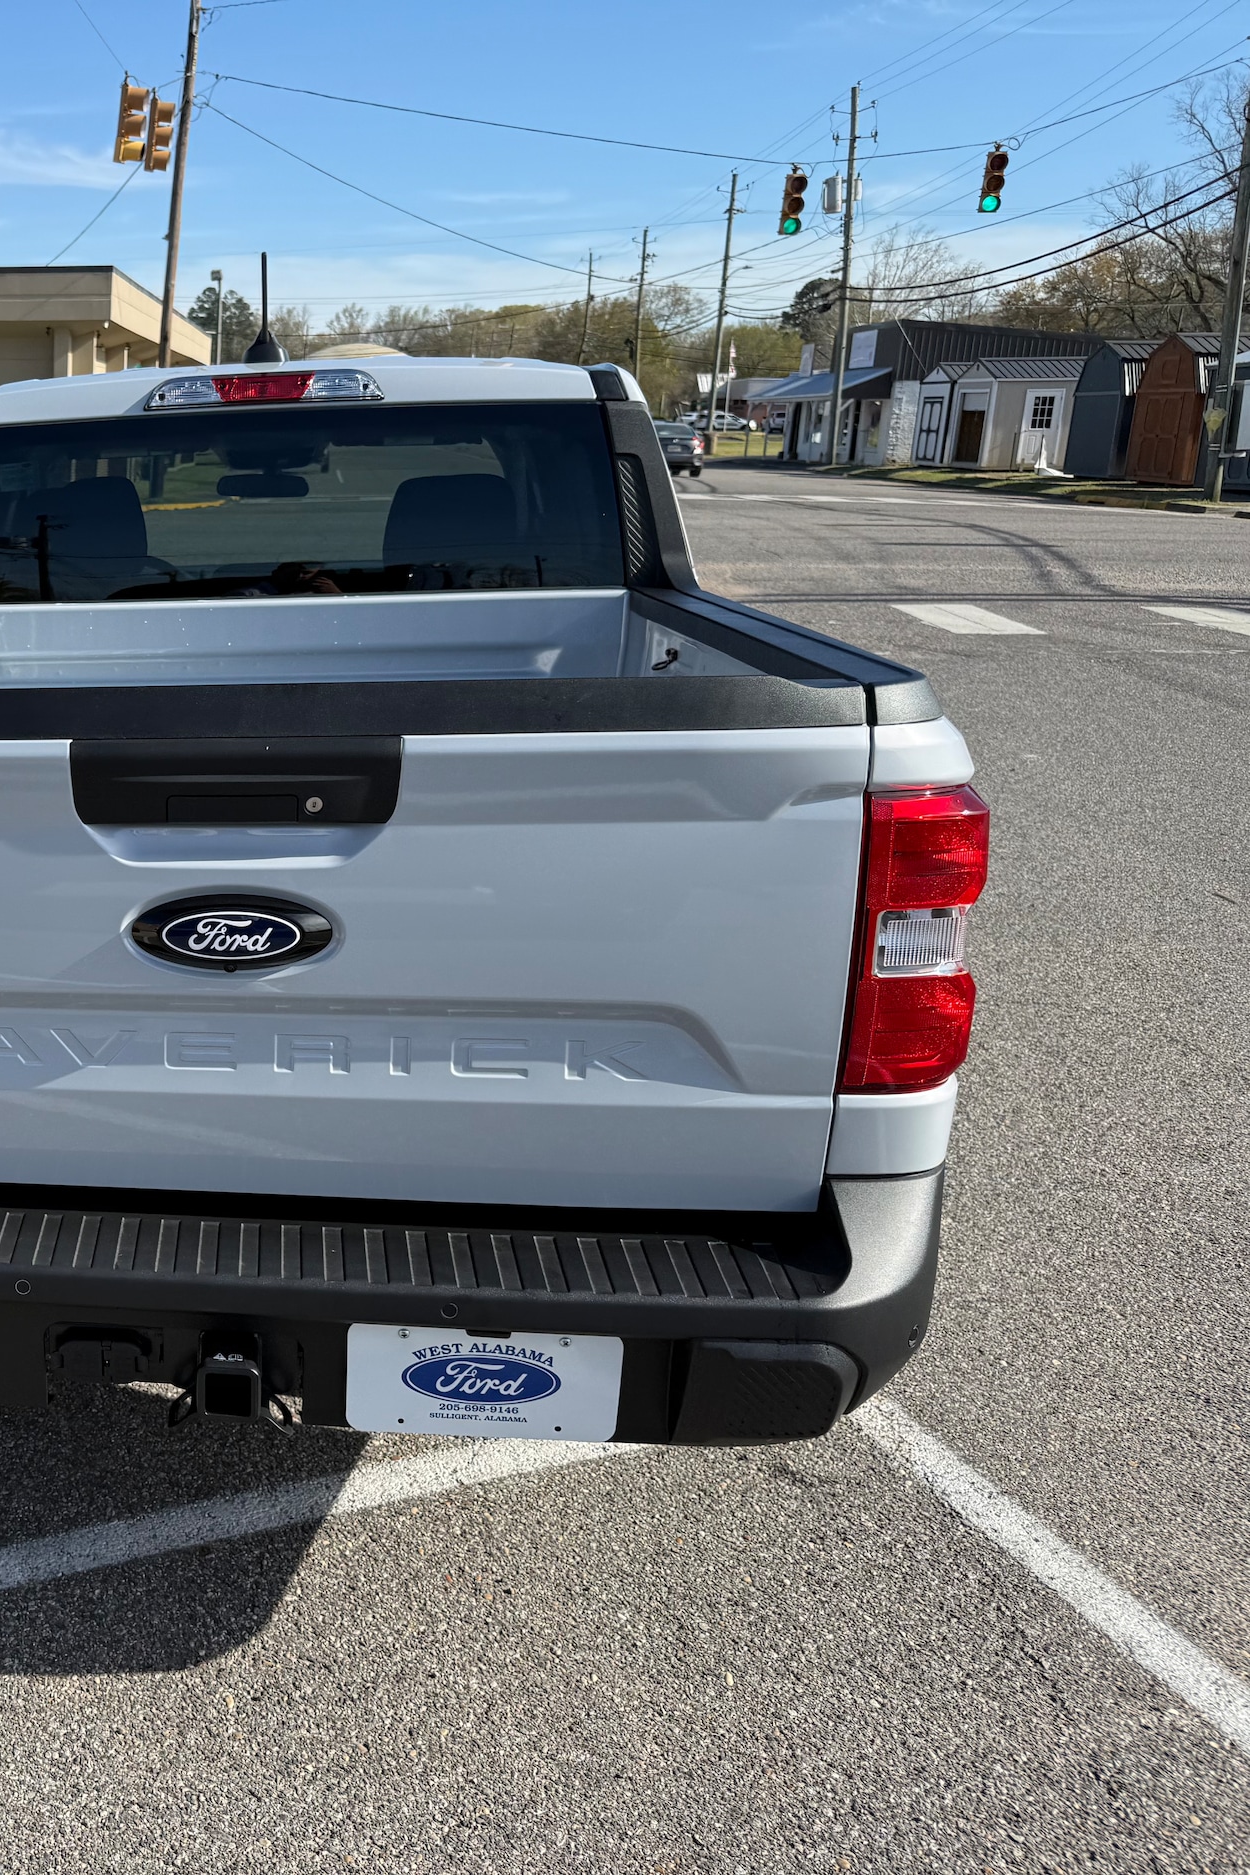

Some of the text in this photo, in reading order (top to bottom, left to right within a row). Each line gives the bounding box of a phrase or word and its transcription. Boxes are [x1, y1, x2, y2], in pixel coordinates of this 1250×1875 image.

[188, 918, 274, 952] Ford
[412, 1342, 554, 1367] WEST ALABAMA
[435, 1361, 528, 1396] Ford
[439, 1403, 519, 1414] 205-698-9146
[484, 1415, 527, 1423] ALABAMA
